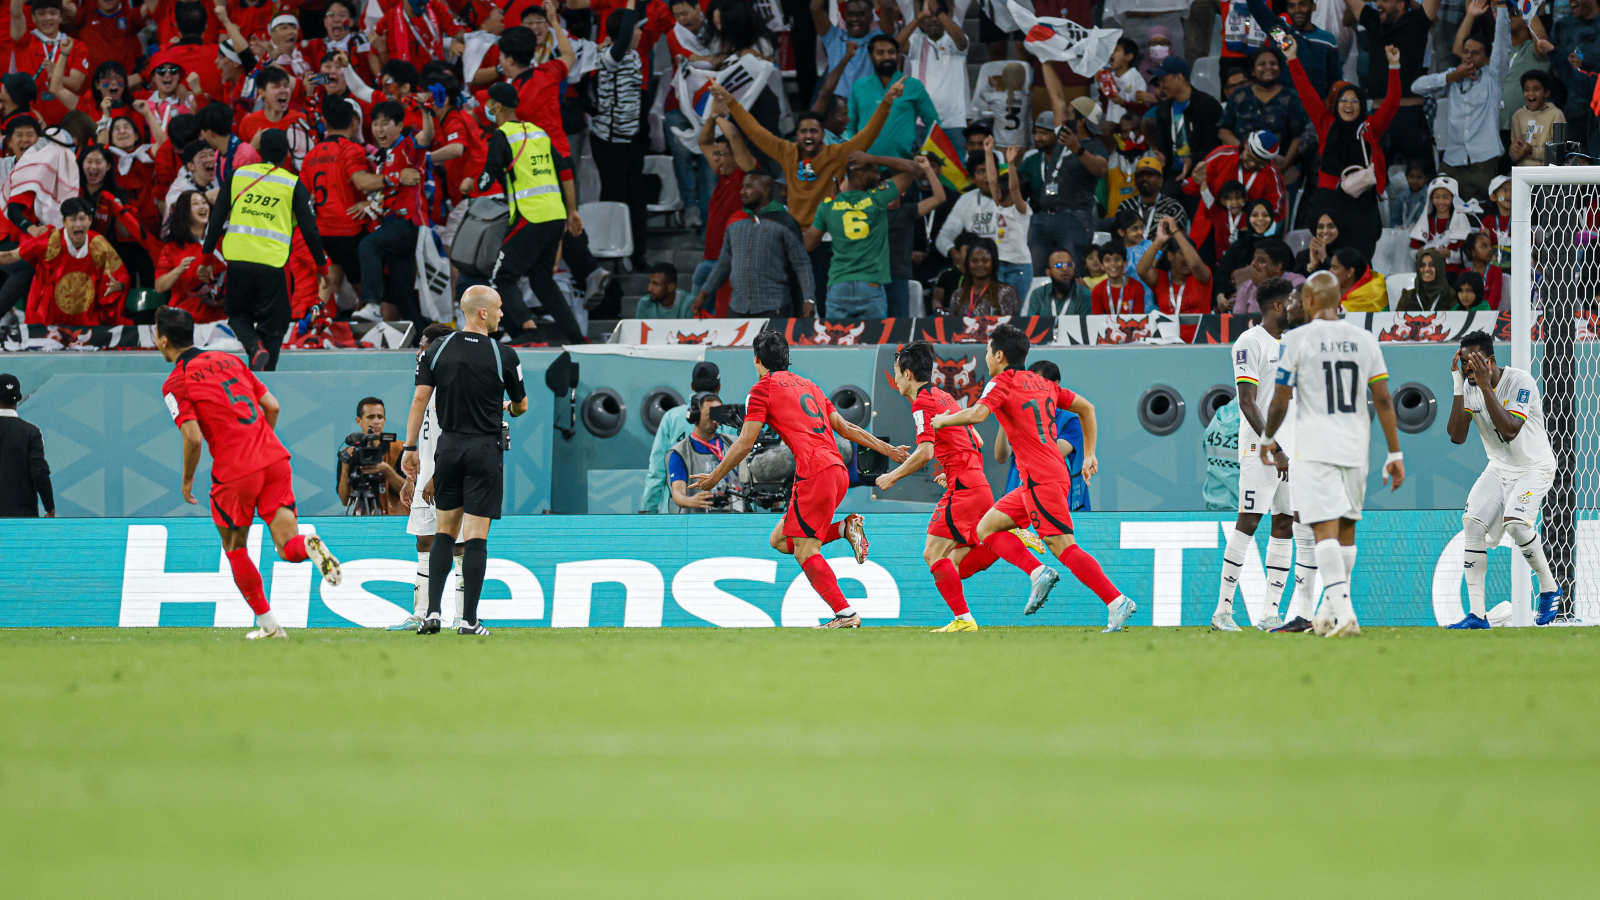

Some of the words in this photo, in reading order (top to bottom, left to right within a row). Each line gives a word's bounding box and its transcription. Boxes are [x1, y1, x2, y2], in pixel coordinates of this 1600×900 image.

[240, 206, 276, 221] Security
[244, 193, 280, 208] 3787
[842, 210, 870, 240] 6
[221, 377, 257, 425] 5
[1322, 360, 1359, 414] 10
[800, 393, 827, 434] 9
[1022, 396, 1059, 445] 18
[1207, 431, 1239, 450] 4523
[1244, 490, 1256, 510] 5
[118, 525, 900, 628] Hisense
